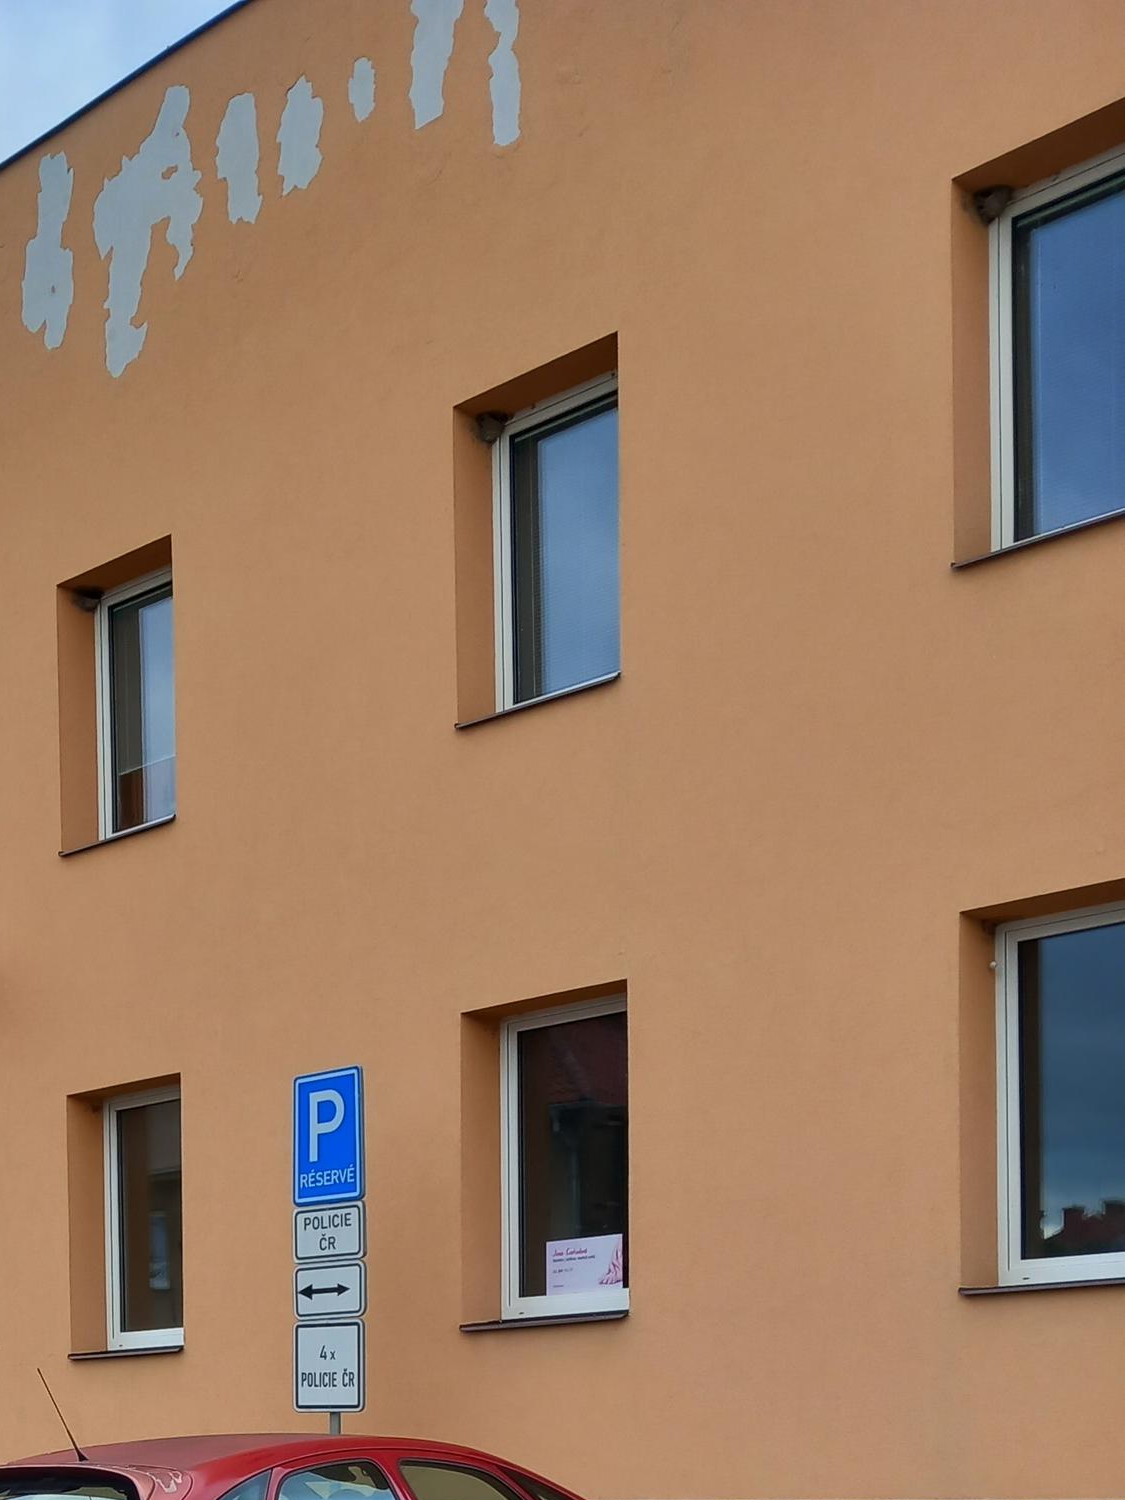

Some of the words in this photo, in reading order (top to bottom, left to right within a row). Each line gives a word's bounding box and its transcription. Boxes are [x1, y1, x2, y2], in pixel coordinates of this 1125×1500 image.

[309, 1089, 345, 1162] P
[300, 1164, 355, 1189] RÉSERVÉ
[304, 1212, 352, 1231] POLICIE
[319, 1233, 336, 1251] ČR
[320, 1345, 327, 1360] 4
[329, 1350, 336, 1360] x
[301, 1371, 337, 1388] POLICIE
[342, 1368, 355, 1388] ČR
